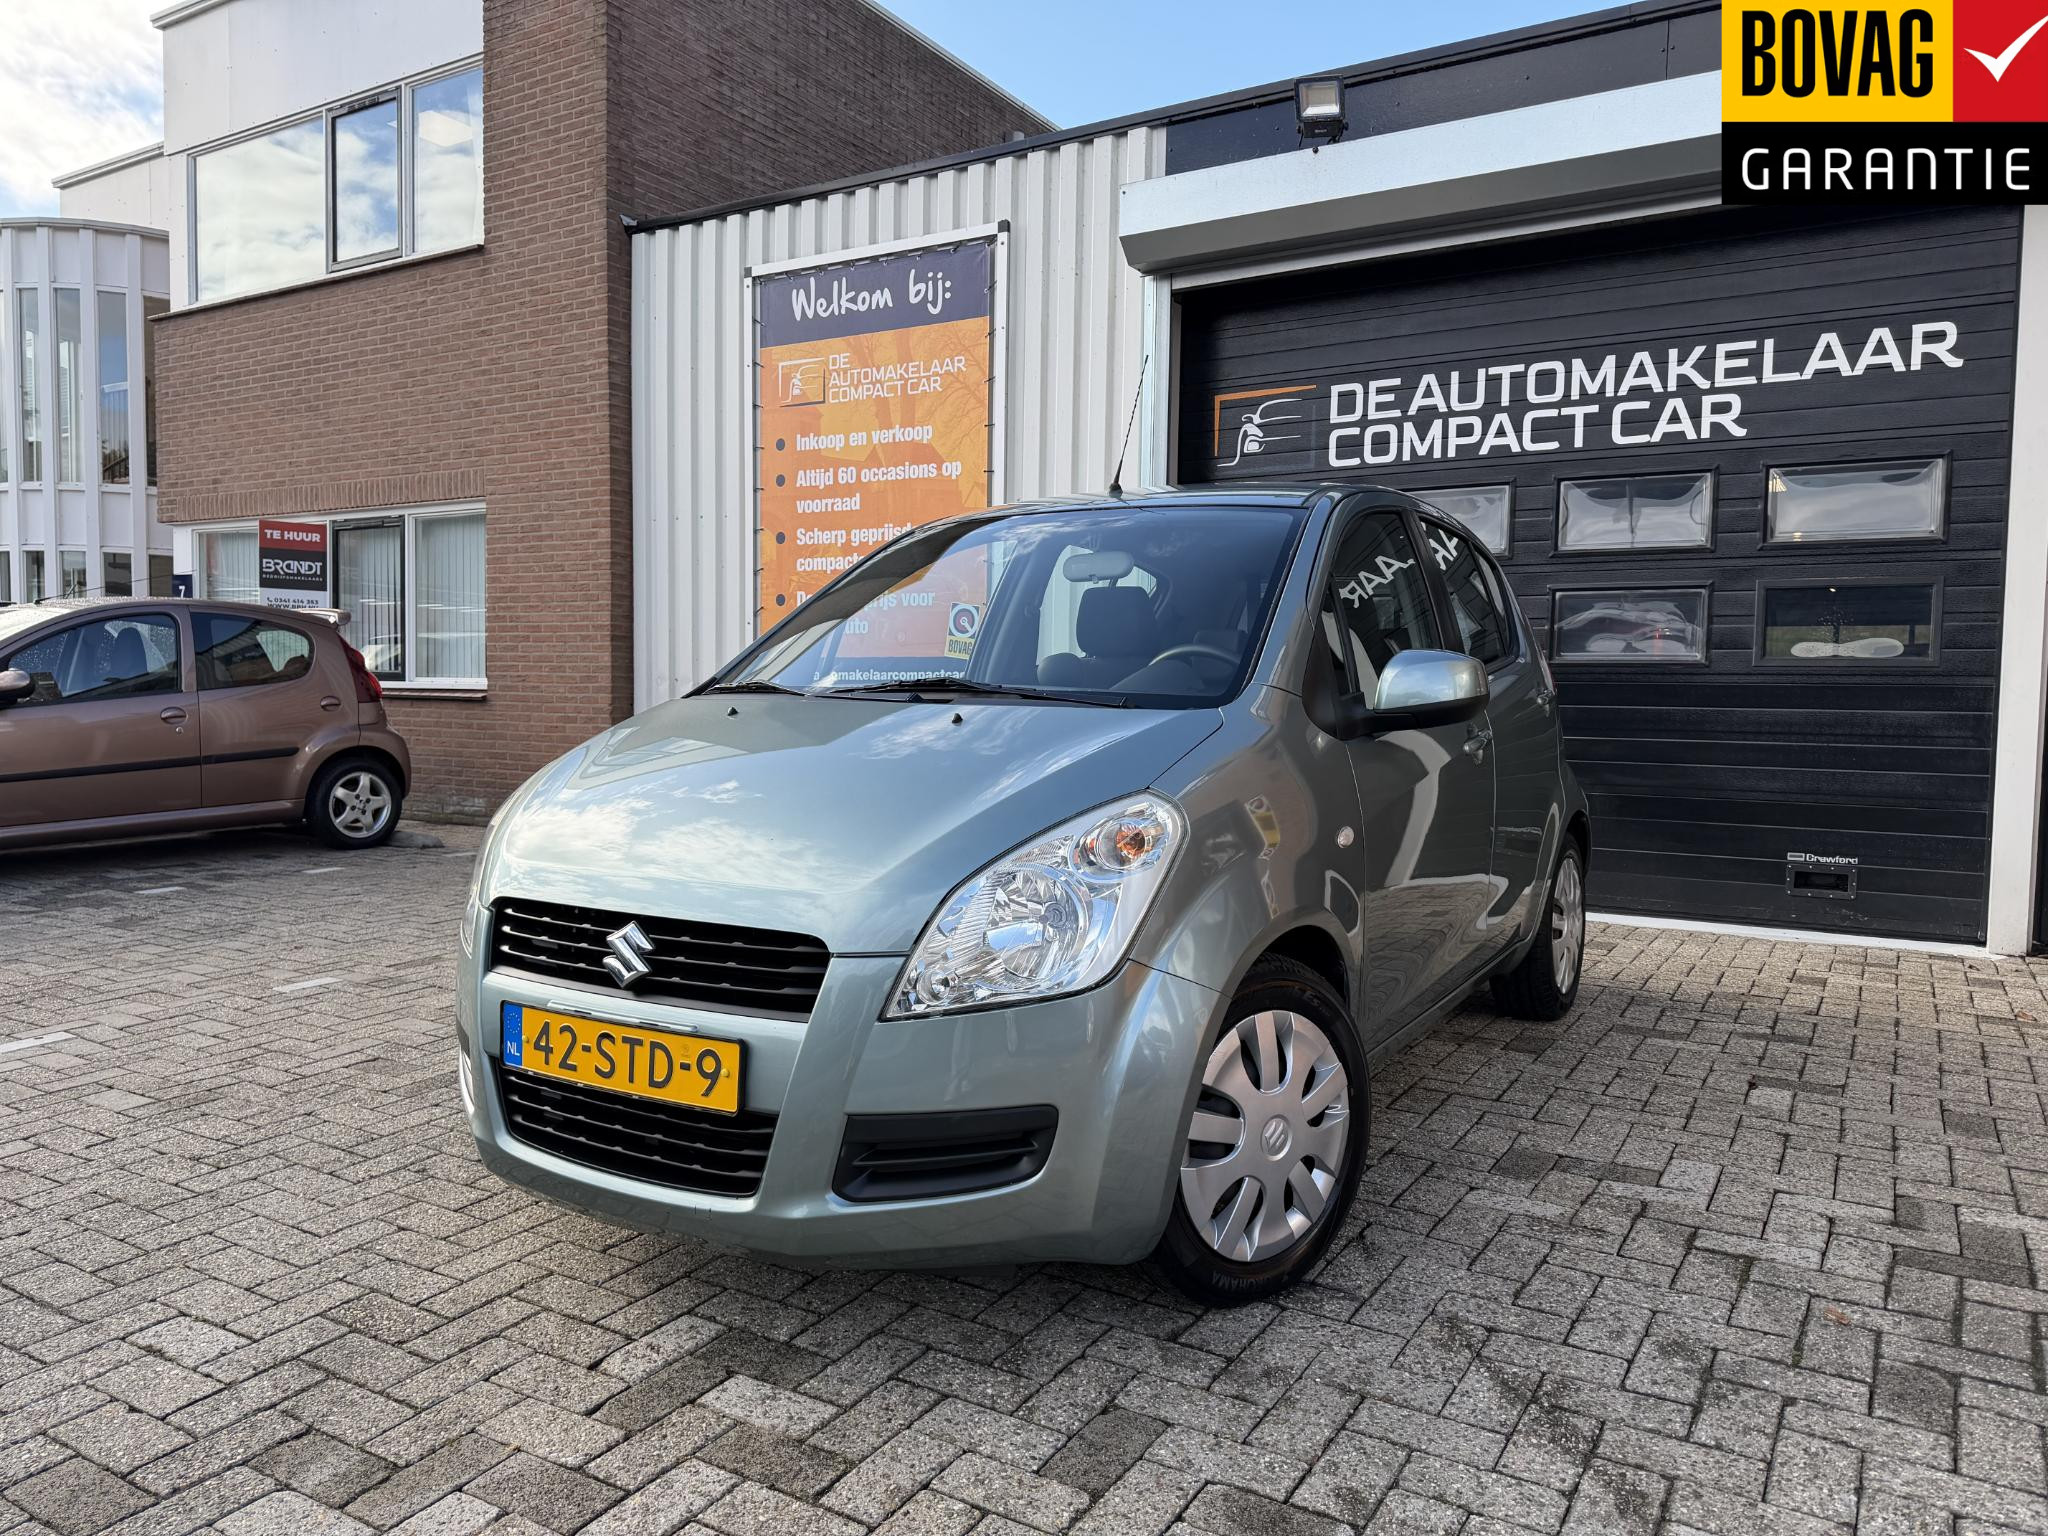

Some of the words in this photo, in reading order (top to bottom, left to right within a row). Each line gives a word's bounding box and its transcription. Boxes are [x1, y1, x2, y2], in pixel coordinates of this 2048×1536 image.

[791, 276, 893, 321] Welkom
[908, 268, 952, 314] bij:
[828, 353, 850, 370] DE
[828, 355, 967, 387] AUTOMAKELAAR
[1329, 377, 1402, 423] DE
[1407, 321, 1964, 416] AUTOMAKELAAR
[829, 382, 903, 403] COMPACT
[907, 377, 942, 395] CAR
[796, 432, 844, 451] Inkoop
[849, 431, 867, 446] en
[872, 425, 933, 445] verkoop
[1328, 405, 1599, 467] COMPACT
[1611, 393, 1747, 445] CAR
[796, 468, 834, 489] Altijd
[838, 467, 856, 484] 60
[861, 462, 937, 482] occasions
[942, 460, 962, 479] op
[796, 493, 860, 513] voorraad
[264, 529, 281, 539] TE
[284, 531, 321, 542] HUUR
[796, 527, 846, 547] Scherp
[262, 558, 323, 575] BRANDT
[178, 585, 186, 599] 7
[901, 592, 936, 607] voor
[948, 638, 973, 655] BOVAG
[1806, 853, 1859, 865] Crawford
[506, 1041, 520, 1057] NL
[533, 1019, 722, 1097] 42-STD-9
